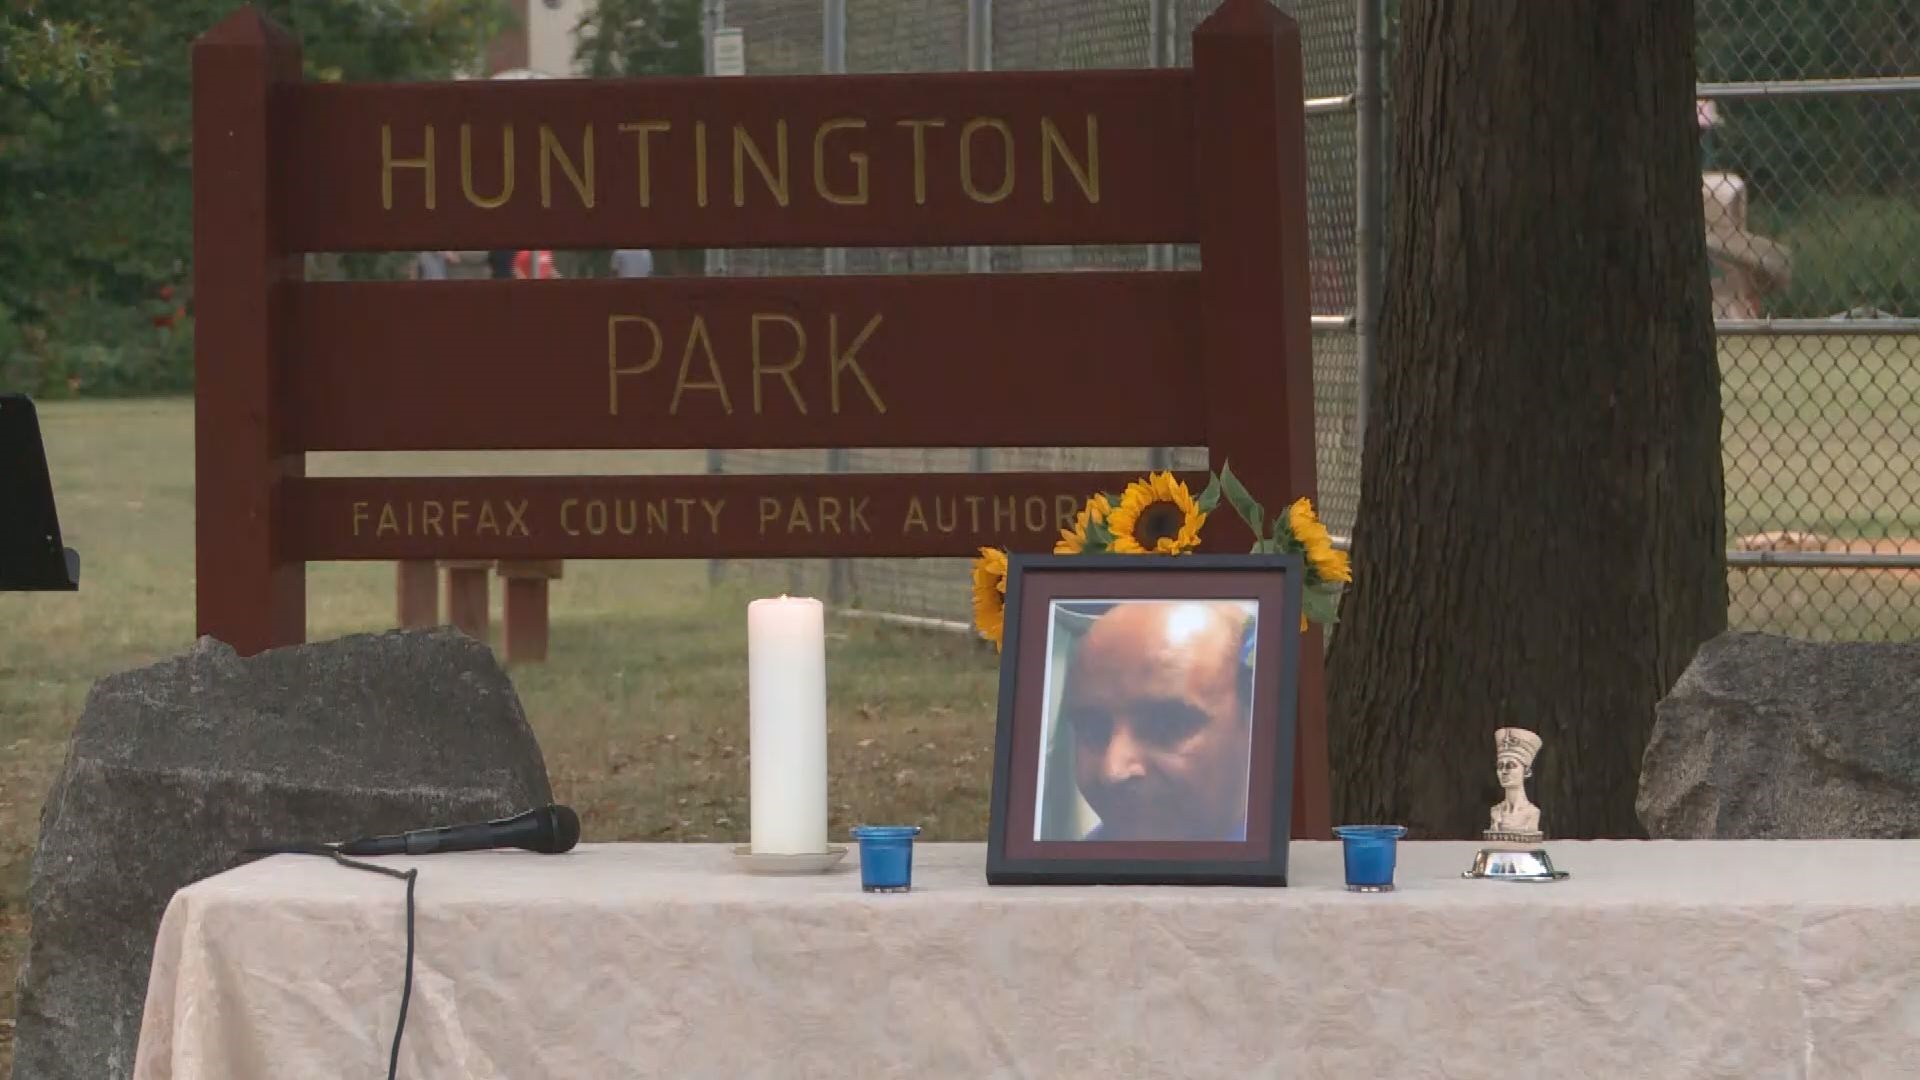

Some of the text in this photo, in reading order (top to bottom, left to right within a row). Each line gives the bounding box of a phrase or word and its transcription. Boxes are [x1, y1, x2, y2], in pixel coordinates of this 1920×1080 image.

[380, 113, 1102, 212] HUNTINGTON
[606, 312, 888, 417] PARK
[351, 494, 1078, 538] FAIRFAX COUNTY PARK AUTHOR
